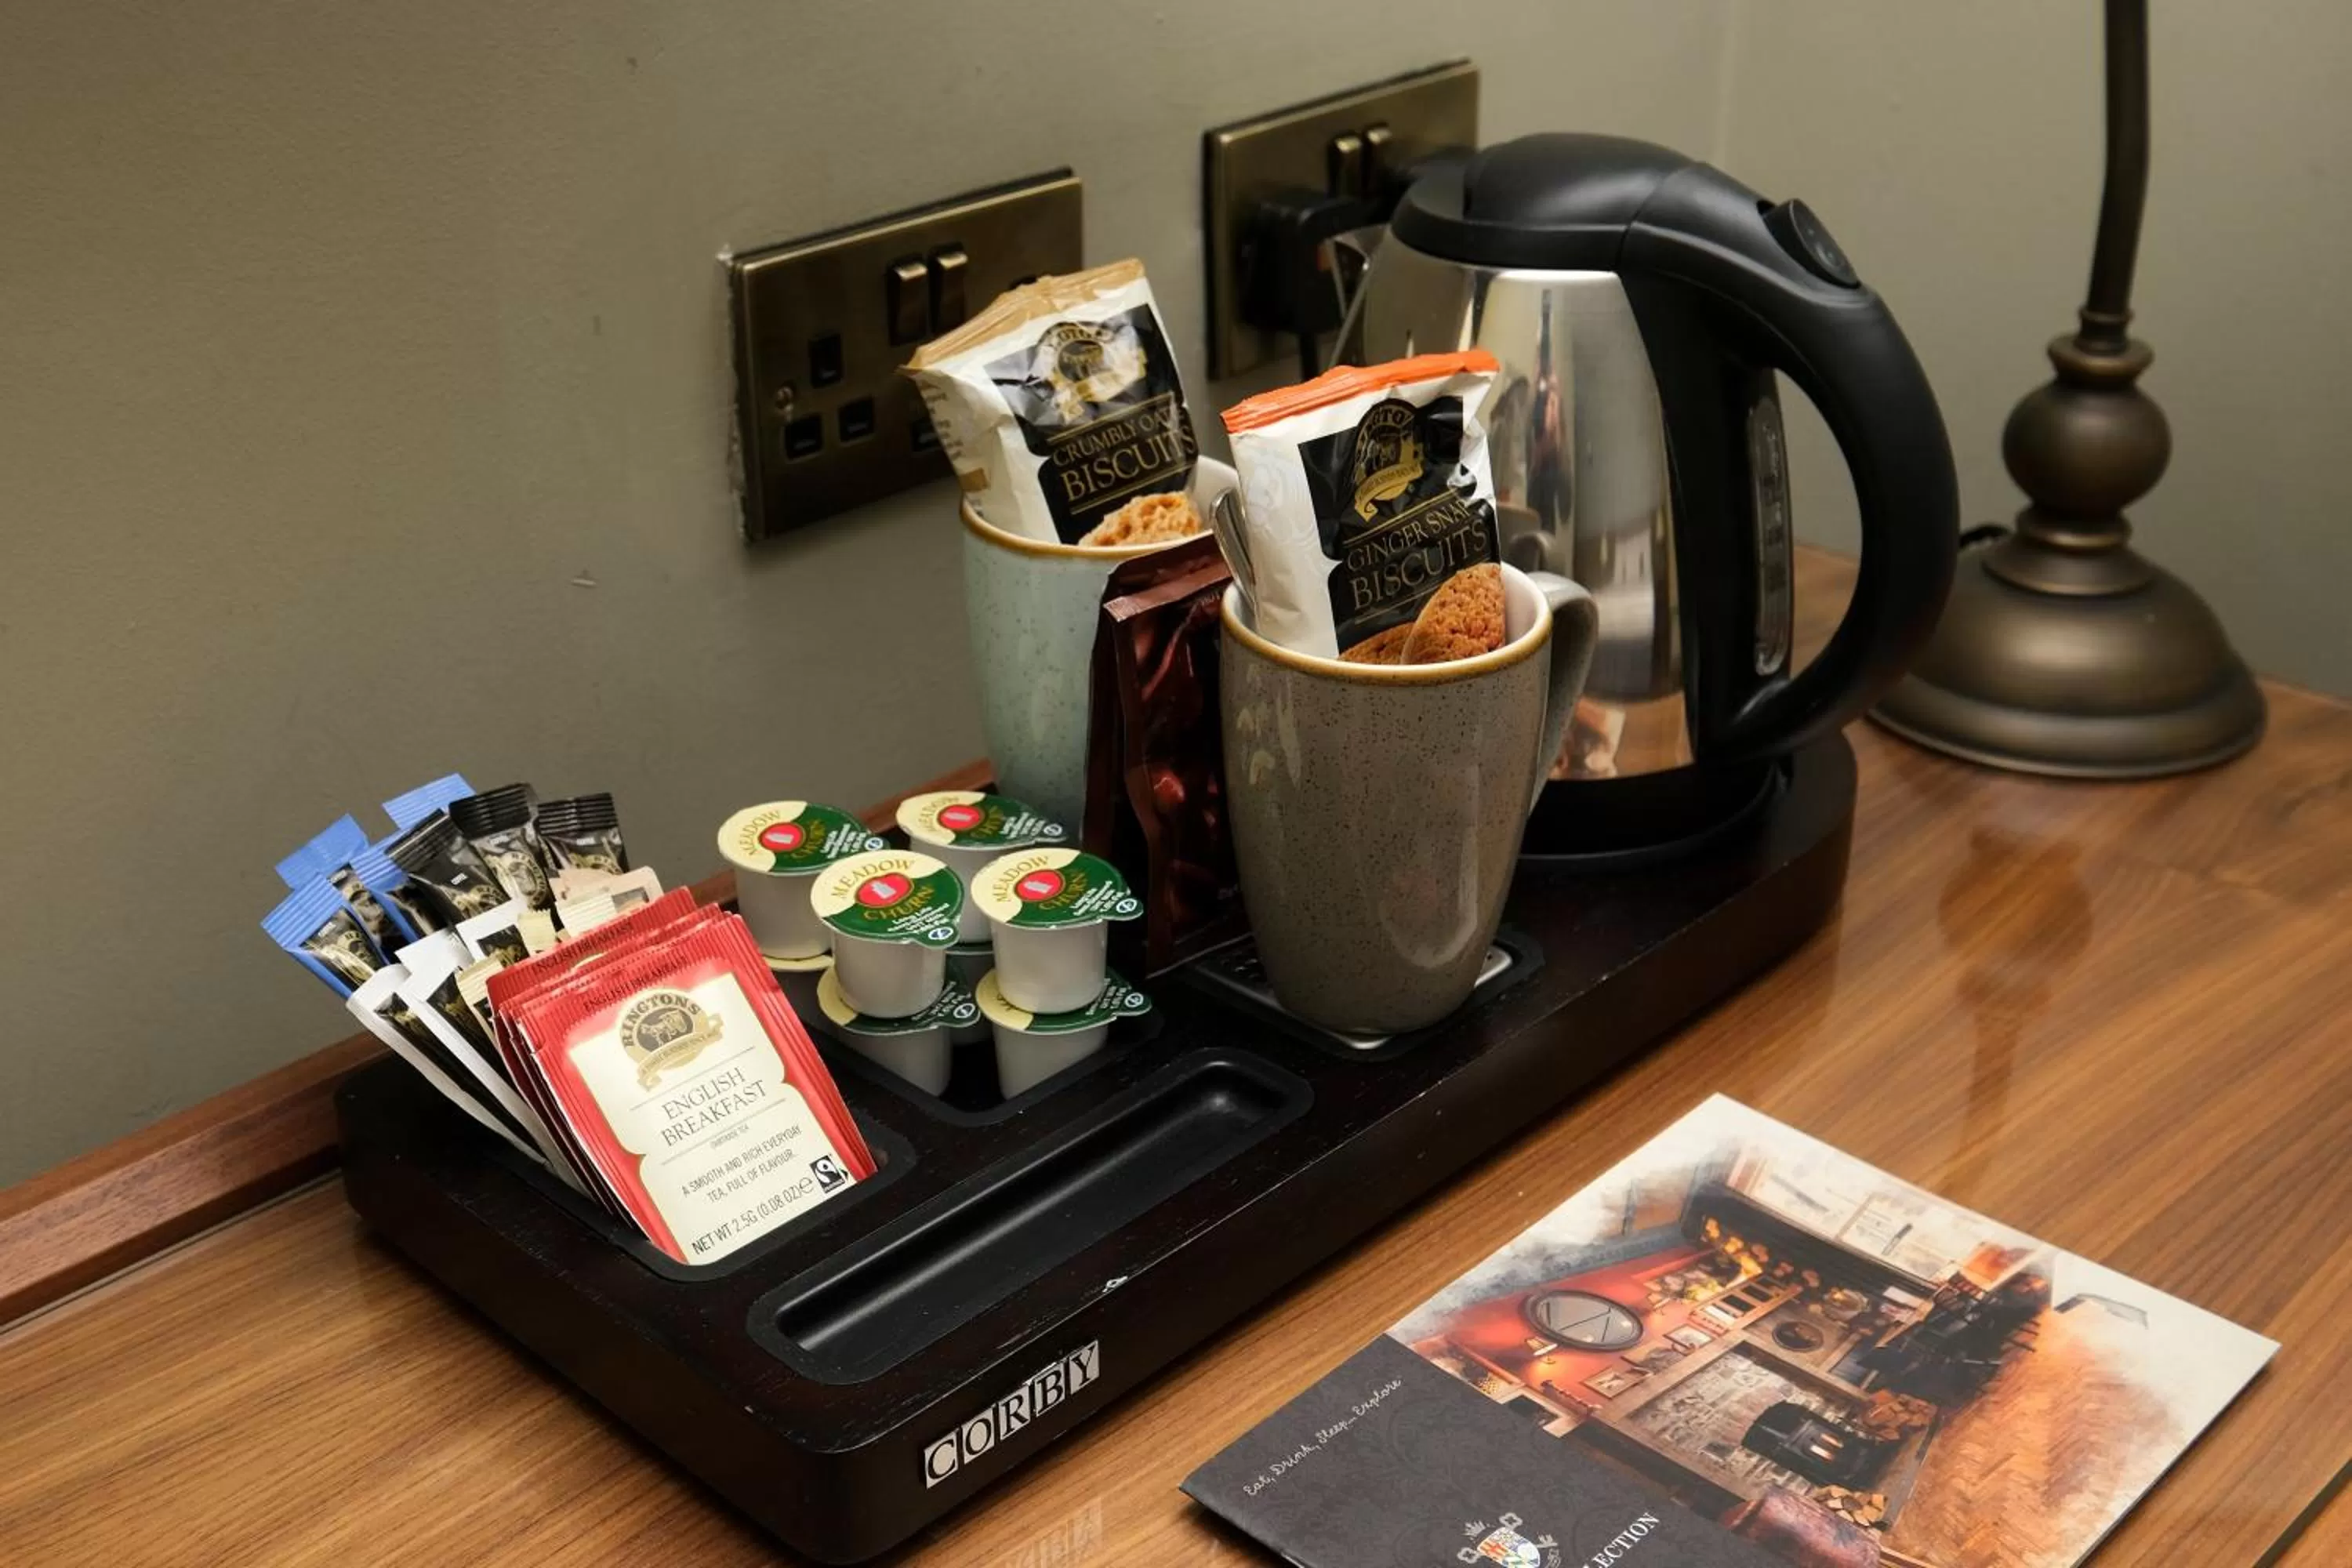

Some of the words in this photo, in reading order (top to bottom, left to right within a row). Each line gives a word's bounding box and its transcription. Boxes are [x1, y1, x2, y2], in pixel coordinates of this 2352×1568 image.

[1053, 418, 1136, 466] CRUMBLY
[1061, 426, 1195, 502] BISCUITS
[1347, 520, 1428, 572] GINGER
[1349, 518, 1487, 611] BISCUITS
[739, 808, 781, 856] MEADOW
[830, 858, 916, 899] MEADOW
[863, 884, 935, 921] CHURN
[992, 855, 1049, 903] MEADOW
[583, 985, 631, 1011] ENGLISH
[622, 992, 702, 1047] RINGTONS
[660, 1079, 767, 1147] BREAKFAST
[661, 1066, 746, 1120] ENGLISH
[681, 1185, 691, 1198] A
[689, 1167, 725, 1192] SMOOTH
[725, 1156, 743, 1173] AND
[742, 1145, 764, 1166] RICH
[760, 1124, 803, 1152] EVERYDAY
[726, 1175, 748, 1192] FULL
[746, 1169, 760, 1182] OF
[691, 1233, 716, 1255] NET
[714, 1222, 732, 1241] WT
[731, 1209, 758, 1233] 2.5G
[926, 1341, 1097, 1482] CORBY
[1243, 1474, 1276, 1495] Eat,
[1269, 1444, 1322, 1475] Drink,
